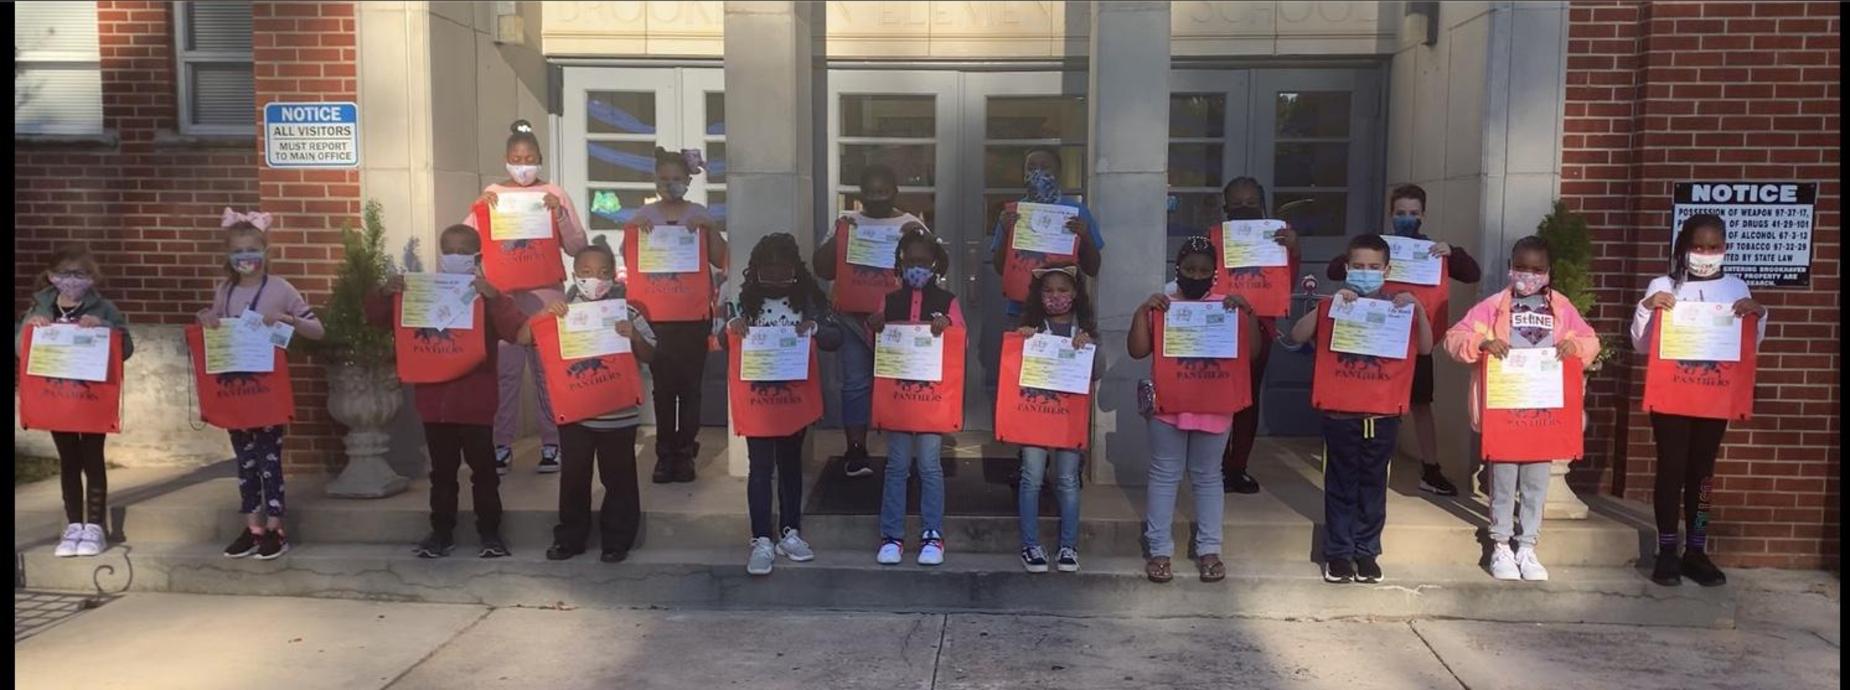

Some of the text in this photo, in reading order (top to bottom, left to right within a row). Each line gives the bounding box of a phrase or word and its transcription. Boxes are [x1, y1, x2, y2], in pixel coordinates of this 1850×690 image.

[281, 106, 342, 122] NOTICE
[273, 126, 351, 136] ALL VISITORS
[280, 142, 347, 151] MUST REPORT
[275, 152, 352, 161] TO MAIN OFFICE
[1691, 184, 1798, 202] NOTICE
[1728, 208, 1738, 216] OF
[1741, 208, 1772, 216] WEAPON
[1729, 220, 1739, 228] OF
[1742, 220, 1768, 228] DRUGS
[1728, 231, 1738, 239] OF
[1741, 231, 1776, 239] ALCOHOL
[1737, 242, 1771, 251] TOBACCO
